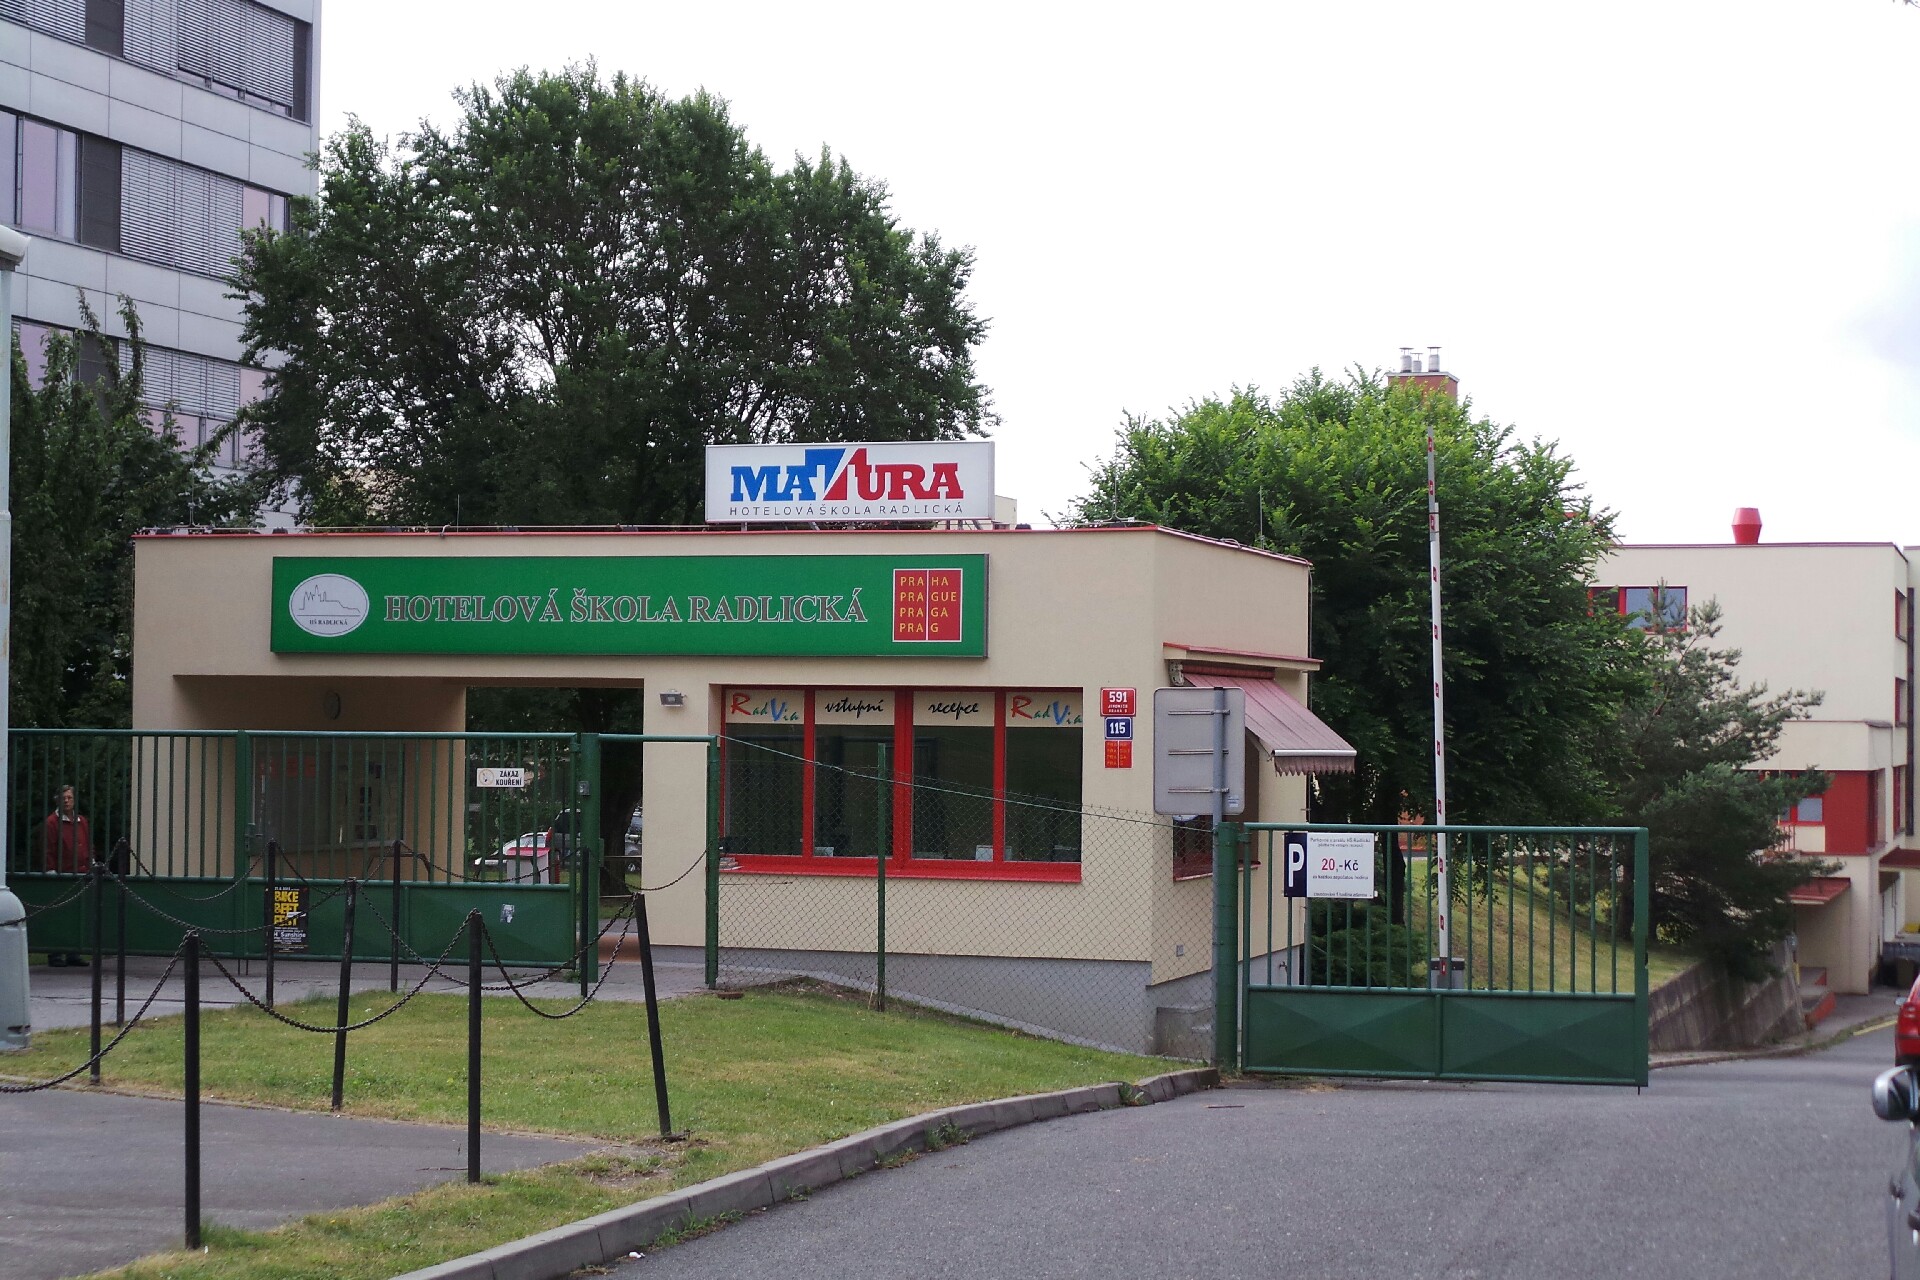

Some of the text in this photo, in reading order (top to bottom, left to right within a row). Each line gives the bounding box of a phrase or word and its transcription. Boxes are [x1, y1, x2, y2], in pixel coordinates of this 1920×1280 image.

[730, 448, 965, 502] MATURA
[879, 502, 964, 515] RADLICKÁ
[384, 587, 868, 623] HOTELOVÁ ŠKOLA RADLICKÁ
[318, 618, 348, 626] RADLICKÁ
[1109, 691, 1128, 703] 591
[731, 693, 799, 721] RadVia
[825, 697, 884, 718] vstupní
[928, 701, 980, 720] recepce
[1011, 695, 1083, 725] RadVia
[1109, 722, 1126, 734] 115
[495, 777, 522, 785] KOUŘENÍ
[1288, 843, 1305, 888] P
[274, 890, 299, 903] BIKE
